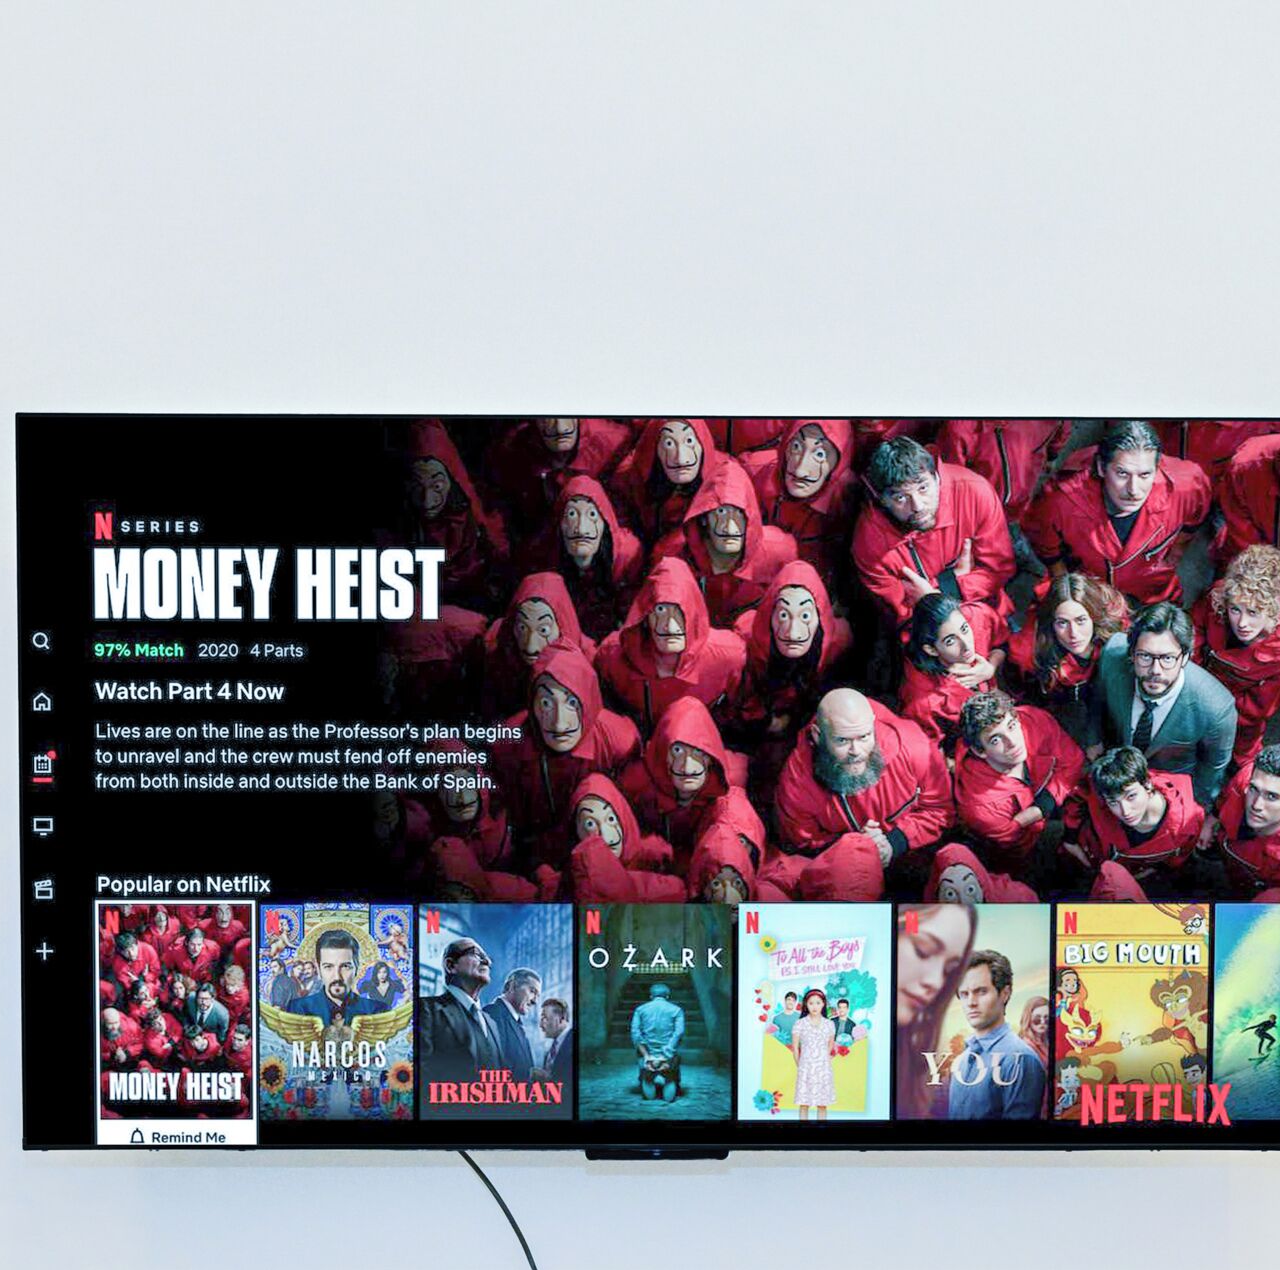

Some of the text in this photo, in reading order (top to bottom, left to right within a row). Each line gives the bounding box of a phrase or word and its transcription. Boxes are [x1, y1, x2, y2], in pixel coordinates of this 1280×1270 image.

[120, 520, 199, 533] SERIES
[93, 548, 446, 620] MONEY HEIST
[94, 643, 304, 657] 97% Match 2020 4 Parts
[95, 682, 285, 700] Watch Part 4 Now
[96, 723, 522, 743] Lives are on the line as the Professor's plan begins
[95, 748, 487, 764] to unravel and the crew must fend off enemies
[95, 773, 497, 792] from both inside and outside the Bank of Spain.
[97, 875, 271, 897] Popular on Netflix
[770, 940, 860, 966] To All the Boys
[1063, 942, 1201, 966] BIG MOUTH
[291, 1041, 387, 1069] NARCOS
[307, 1070, 372, 1082] MEXICO
[478, 1069, 513, 1082] THE
[922, 1052, 1021, 1088] YOU
[108, 1072, 244, 1101] MONEY HEIST
[428, 1082, 563, 1104] IRISHMAN
[1079, 1083, 1232, 1127] NETFLIX
[151, 1131, 227, 1144] Remind Me
